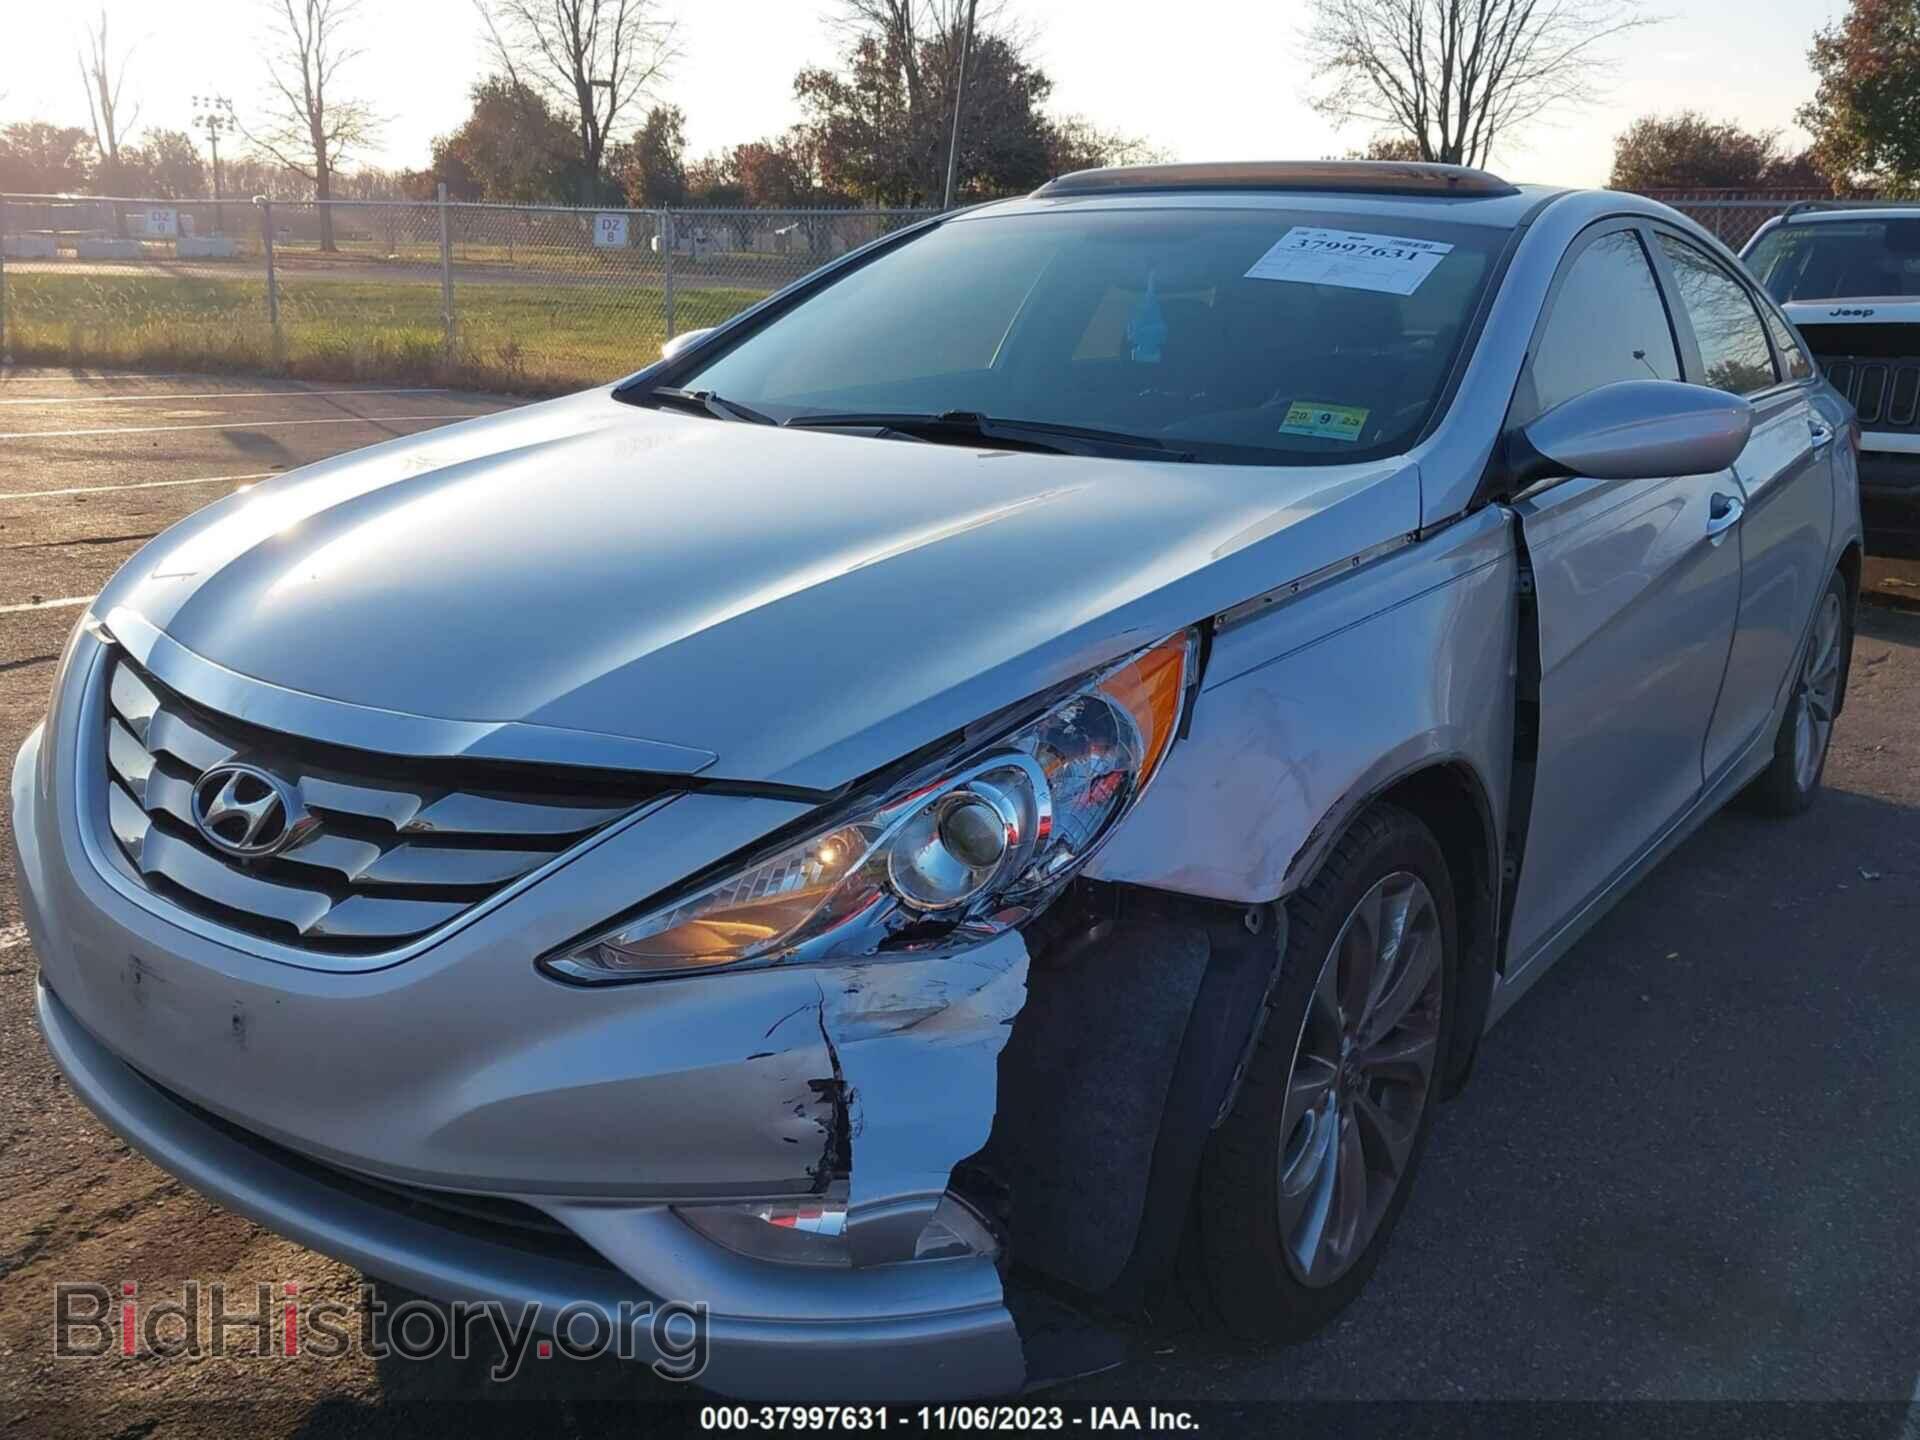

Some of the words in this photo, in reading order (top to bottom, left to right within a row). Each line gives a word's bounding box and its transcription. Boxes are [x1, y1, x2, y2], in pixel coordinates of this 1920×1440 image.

[1290, 239, 1418, 261] 37997631
[1829, 307, 1874, 318] Jeep
[1319, 412, 1332, 425] 9
